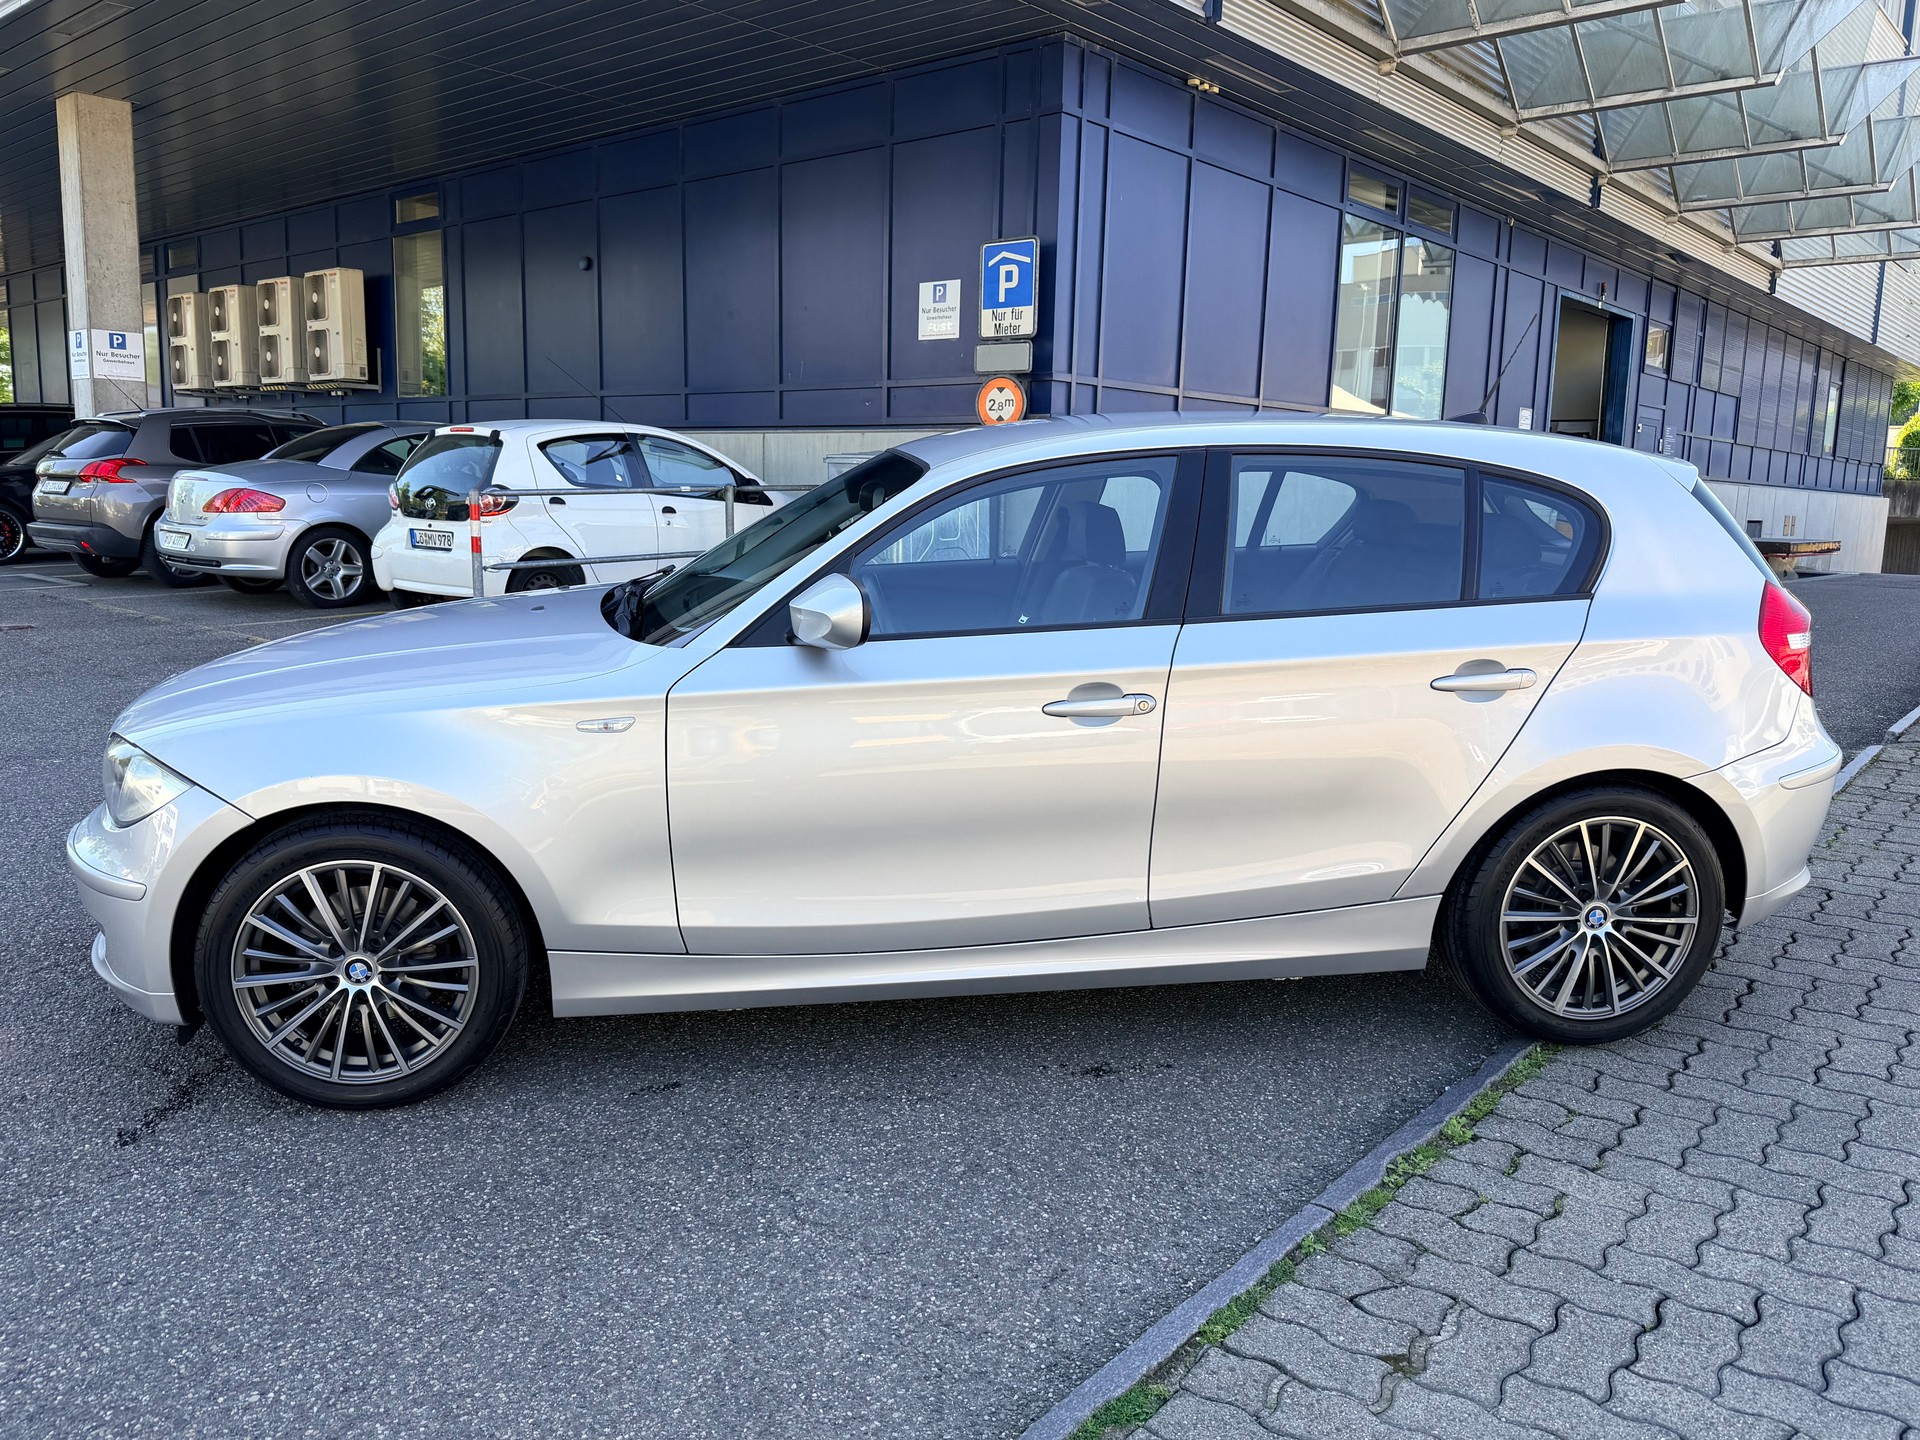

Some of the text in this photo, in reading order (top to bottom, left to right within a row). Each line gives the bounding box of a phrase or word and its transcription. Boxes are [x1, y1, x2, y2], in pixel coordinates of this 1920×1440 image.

[998, 264, 1019, 303] P
[936, 286, 944, 301] P
[933, 306, 957, 314] Besucher
[992, 308, 1023, 322] Nur für
[994, 322, 1021, 335] Mieter
[113, 335, 122, 348] P
[111, 351, 140, 359] Besucher
[416, 532, 424, 544] LÖ
[438, 534, 452, 546] 978
